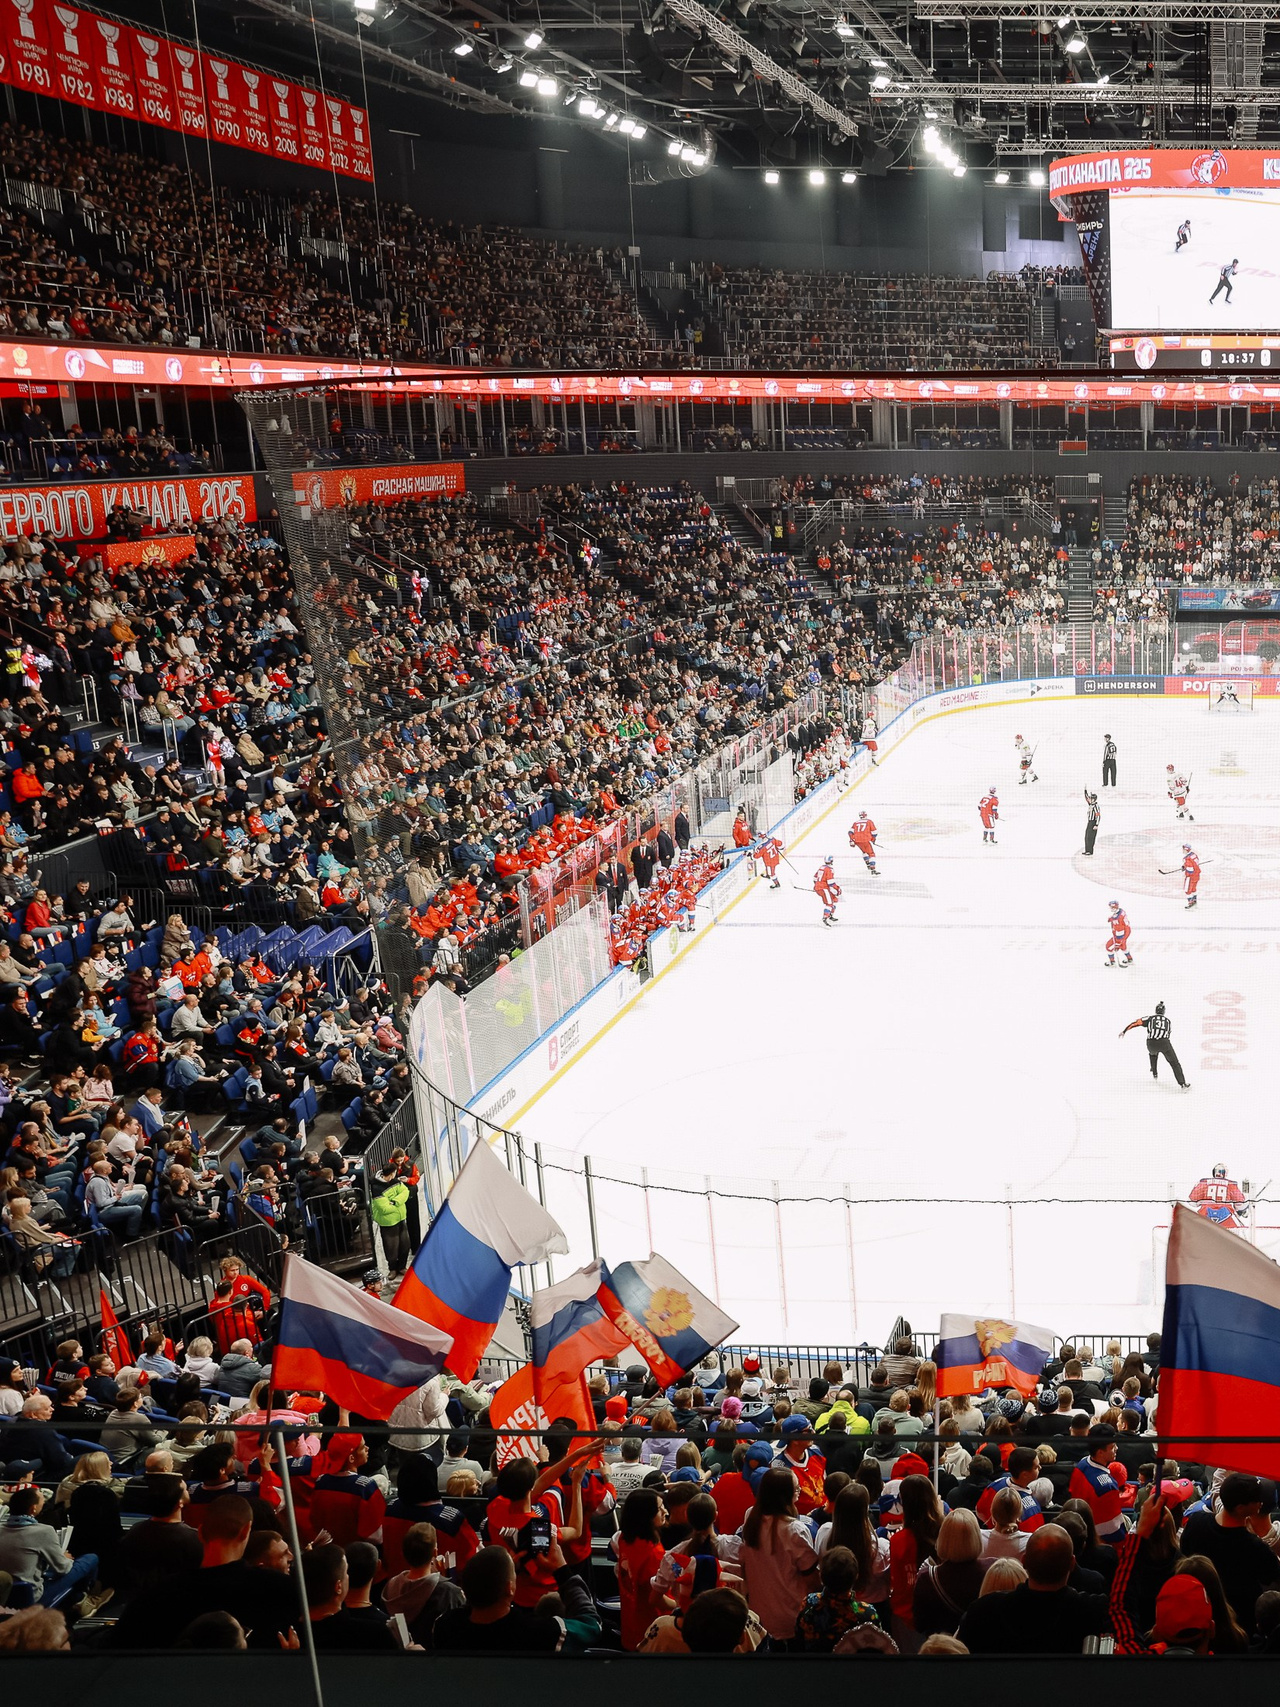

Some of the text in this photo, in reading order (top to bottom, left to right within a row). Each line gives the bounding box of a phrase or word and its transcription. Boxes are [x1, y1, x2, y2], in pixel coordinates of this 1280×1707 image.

[18, 60, 50, 88] 1981
[61, 74, 94, 100] 1982
[104, 86, 134, 111] 1983
[143, 98, 172, 122] 1986
[214, 118, 240, 140] 1990
[246, 126, 269, 148] 1993
[275, 136, 298, 156] 2008
[303, 144, 324, 162] 2009
[329, 152, 349, 170] 2012
[1088, 231, 1101, 264] АРЕНА
[1222, 353, 1254, 364] 18:37
[373, 475, 446, 496] КРАСНАЯ МАШИНА
[200, 480, 246, 524] 2025
[951, 690, 980, 702] MACHINE
[1097, 682, 1156, 690] HENDERSON
[157, 756, 164, 764] 12
[560, 1020, 579, 1048] СПОРТ
[1156, 1020, 1166, 1029] 31
[1201, 989, 1248, 1070] РОЛЬФ
[1207, 1186, 1228, 1200] 99
[620, 1472, 644, 1480] FRIENDS
